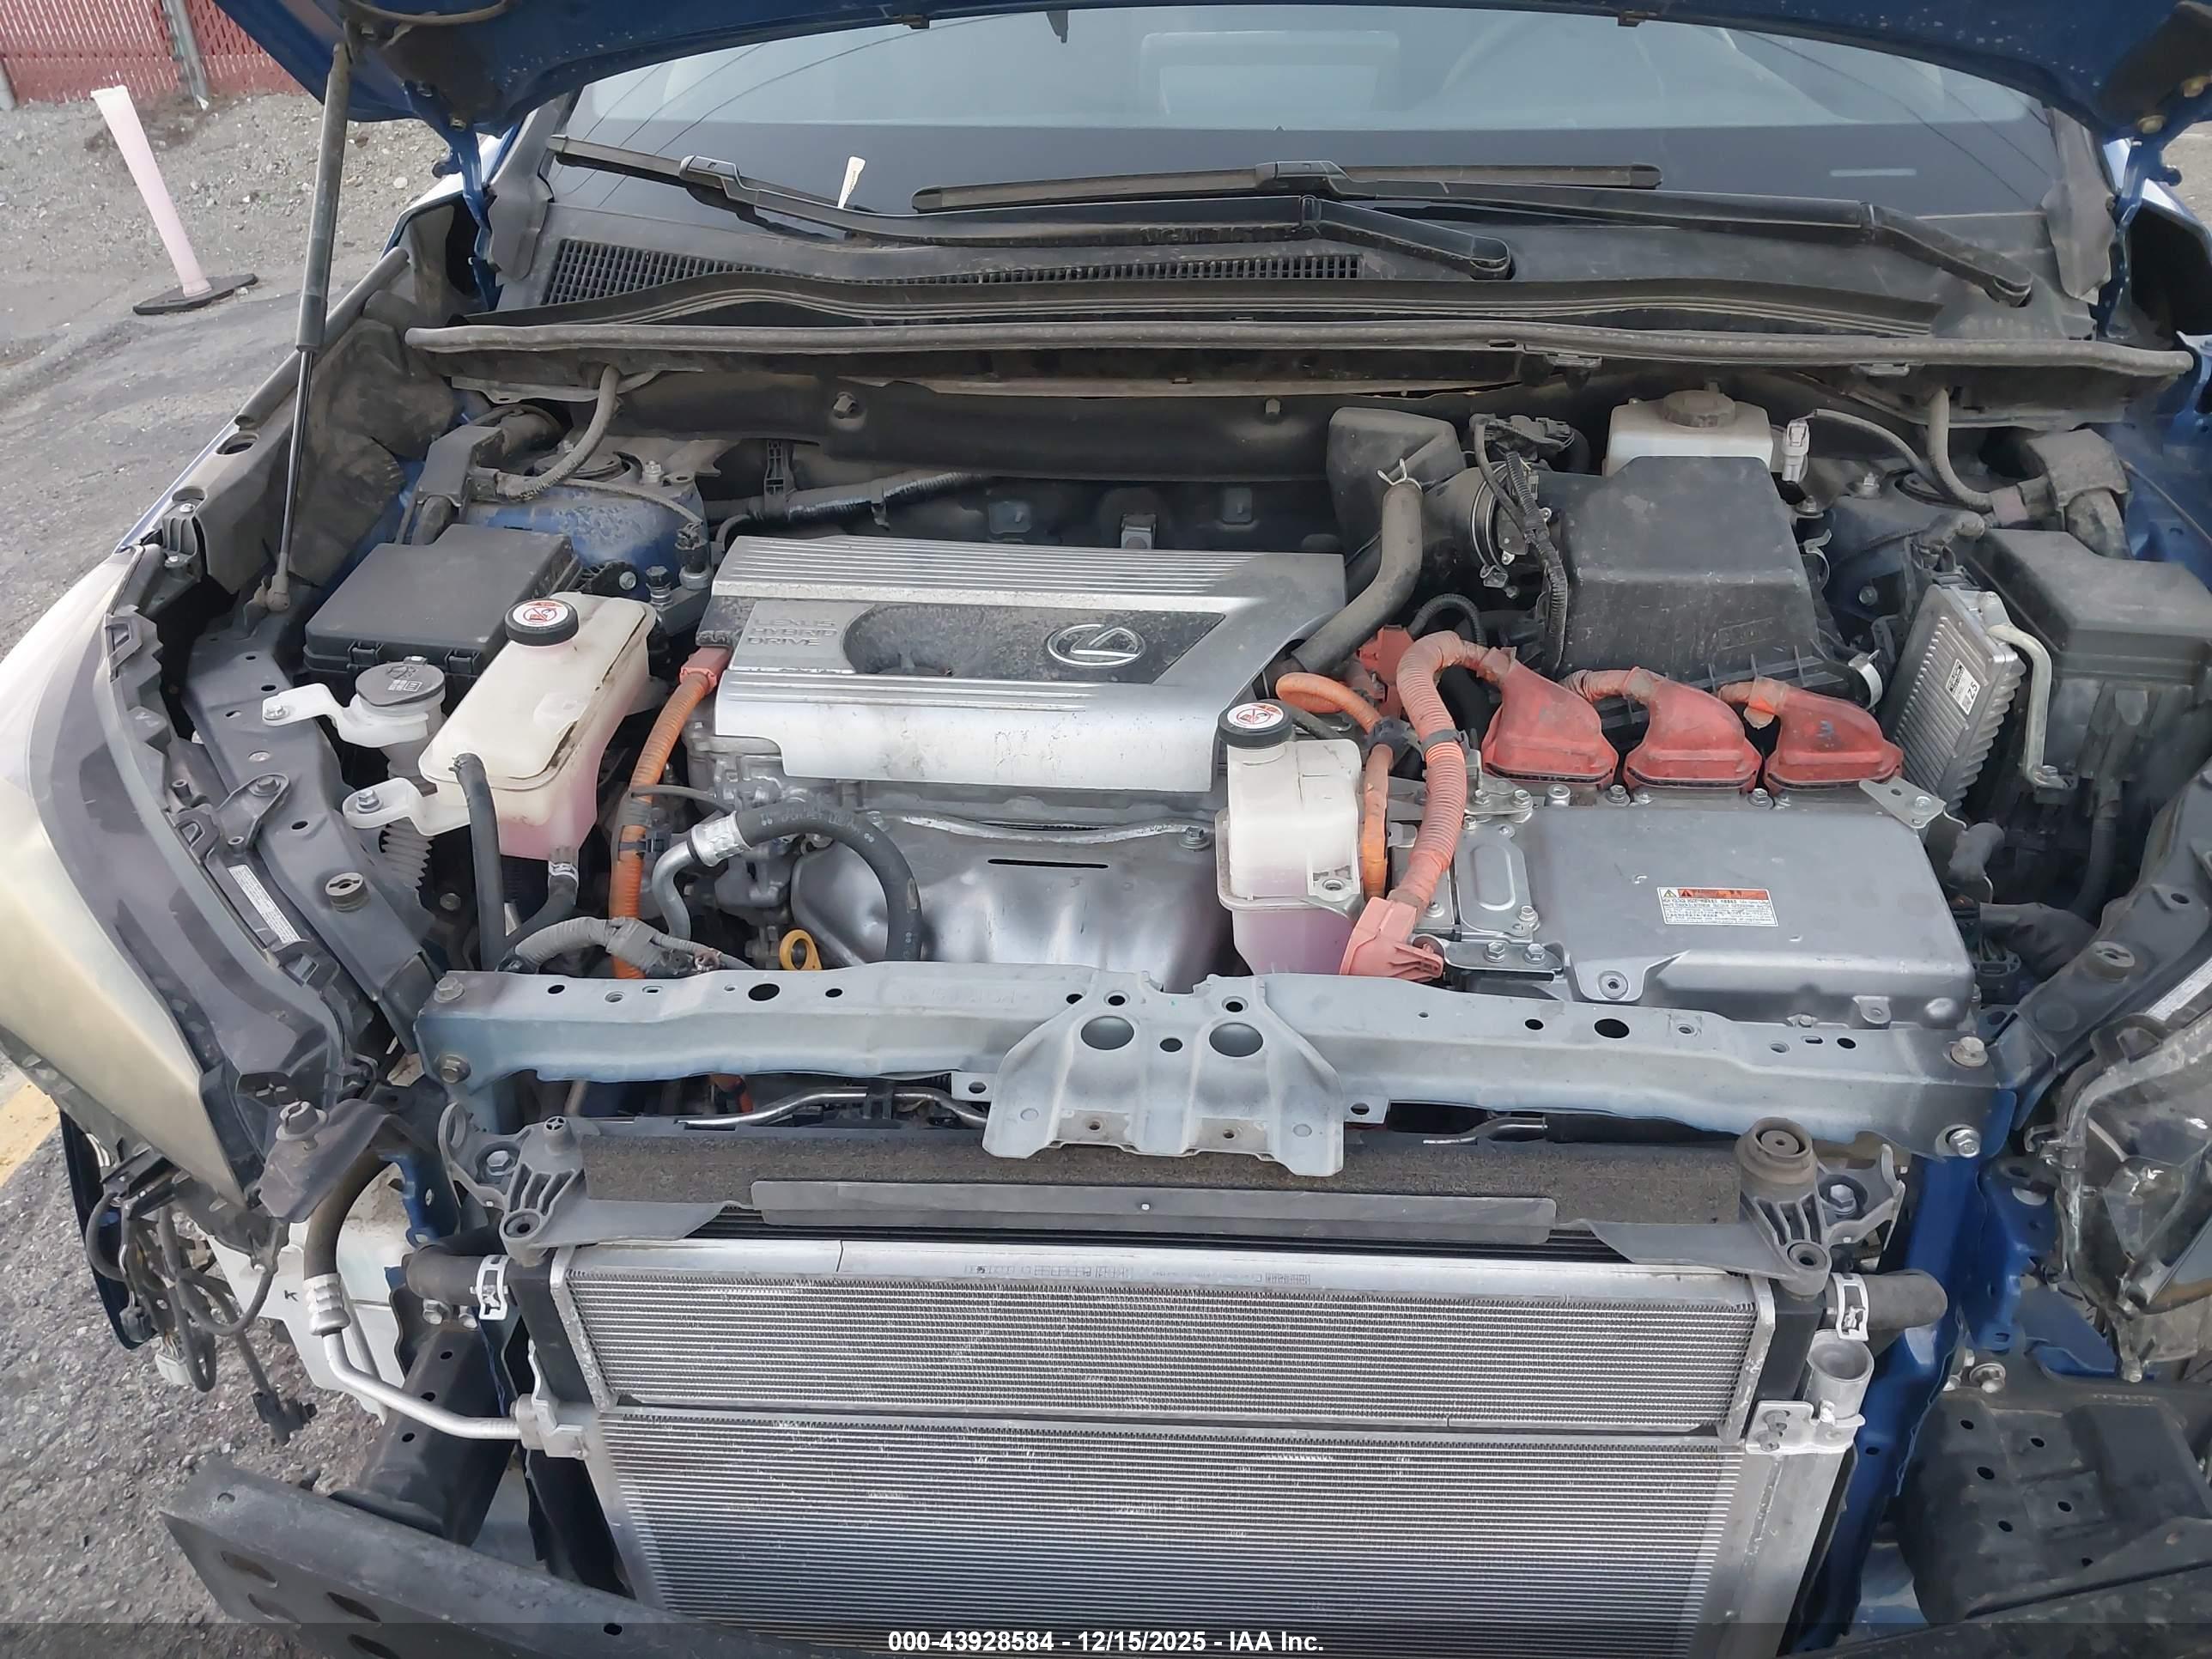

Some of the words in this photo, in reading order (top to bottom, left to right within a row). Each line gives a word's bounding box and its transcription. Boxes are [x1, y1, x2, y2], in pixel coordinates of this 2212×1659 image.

[755, 618, 836, 627] LEXUS
[752, 628, 838, 636] HYBRID
[748, 636, 821, 646] DRIVE
